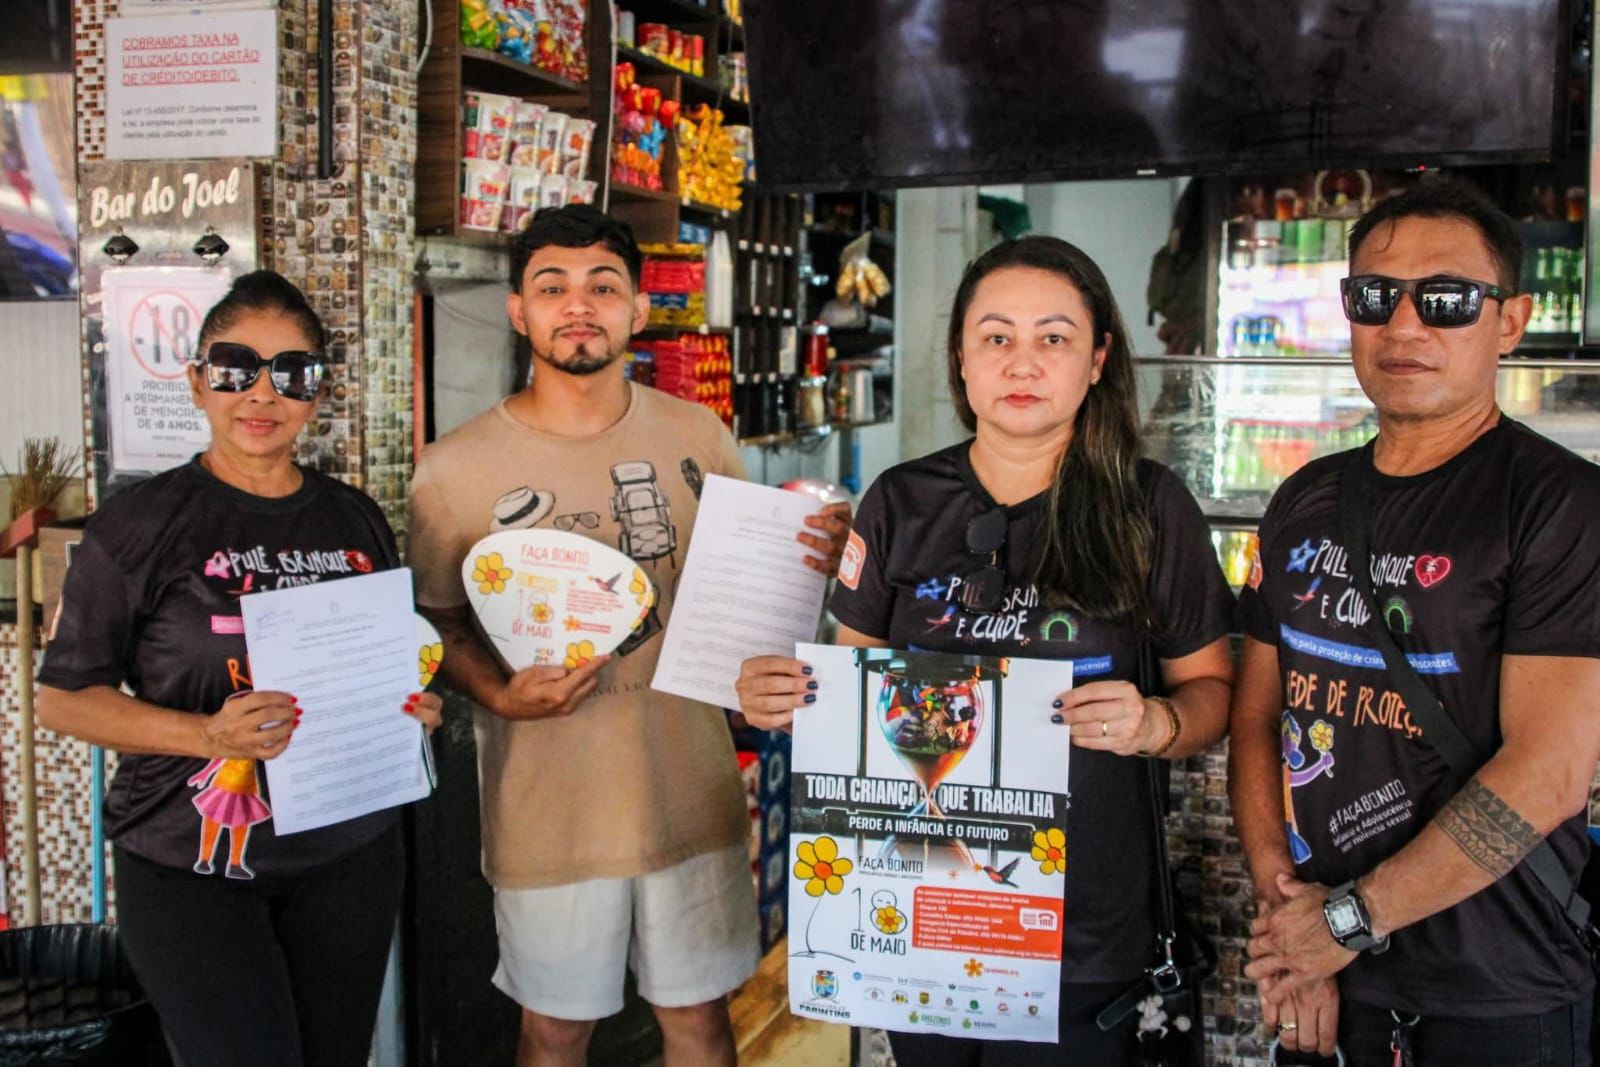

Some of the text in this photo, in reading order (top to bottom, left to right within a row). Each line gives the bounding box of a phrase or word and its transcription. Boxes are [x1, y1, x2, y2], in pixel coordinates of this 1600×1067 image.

[122, 32, 240, 50] COBRAMOS TAXA NA
[122, 48, 260, 68] UTILIZAÇÃO DO CARTÃO
[122, 73, 139, 85] DE
[90, 167, 240, 228] Bar do Joel
[142, 380, 190, 392] PROIBID
[124, 393, 132, 403] A
[133, 405, 148, 417] DE
[137, 418, 151, 430] DE
[277, 549, 353, 574] BRINQUE
[1320, 594, 1330, 619] E
[955, 609, 1028, 643] E CUIDE
[1326, 679, 1347, 717] DE
[805, 774, 847, 801] TODA
[850, 777, 918, 810] CRIANÇA
[938, 784, 969, 814] QUE
[972, 786, 1055, 819] TRABALHA
[849, 816, 1009, 842] PERDE A INFÂNCIA E O FUTURO
[858, 855, 924, 874] FAÇA BONITO
[851, 887, 908, 936] 18
[851, 932, 866, 951] DE
[870, 936, 907, 956] MAIO
[799, 1004, 851, 1019] PARINTINS
